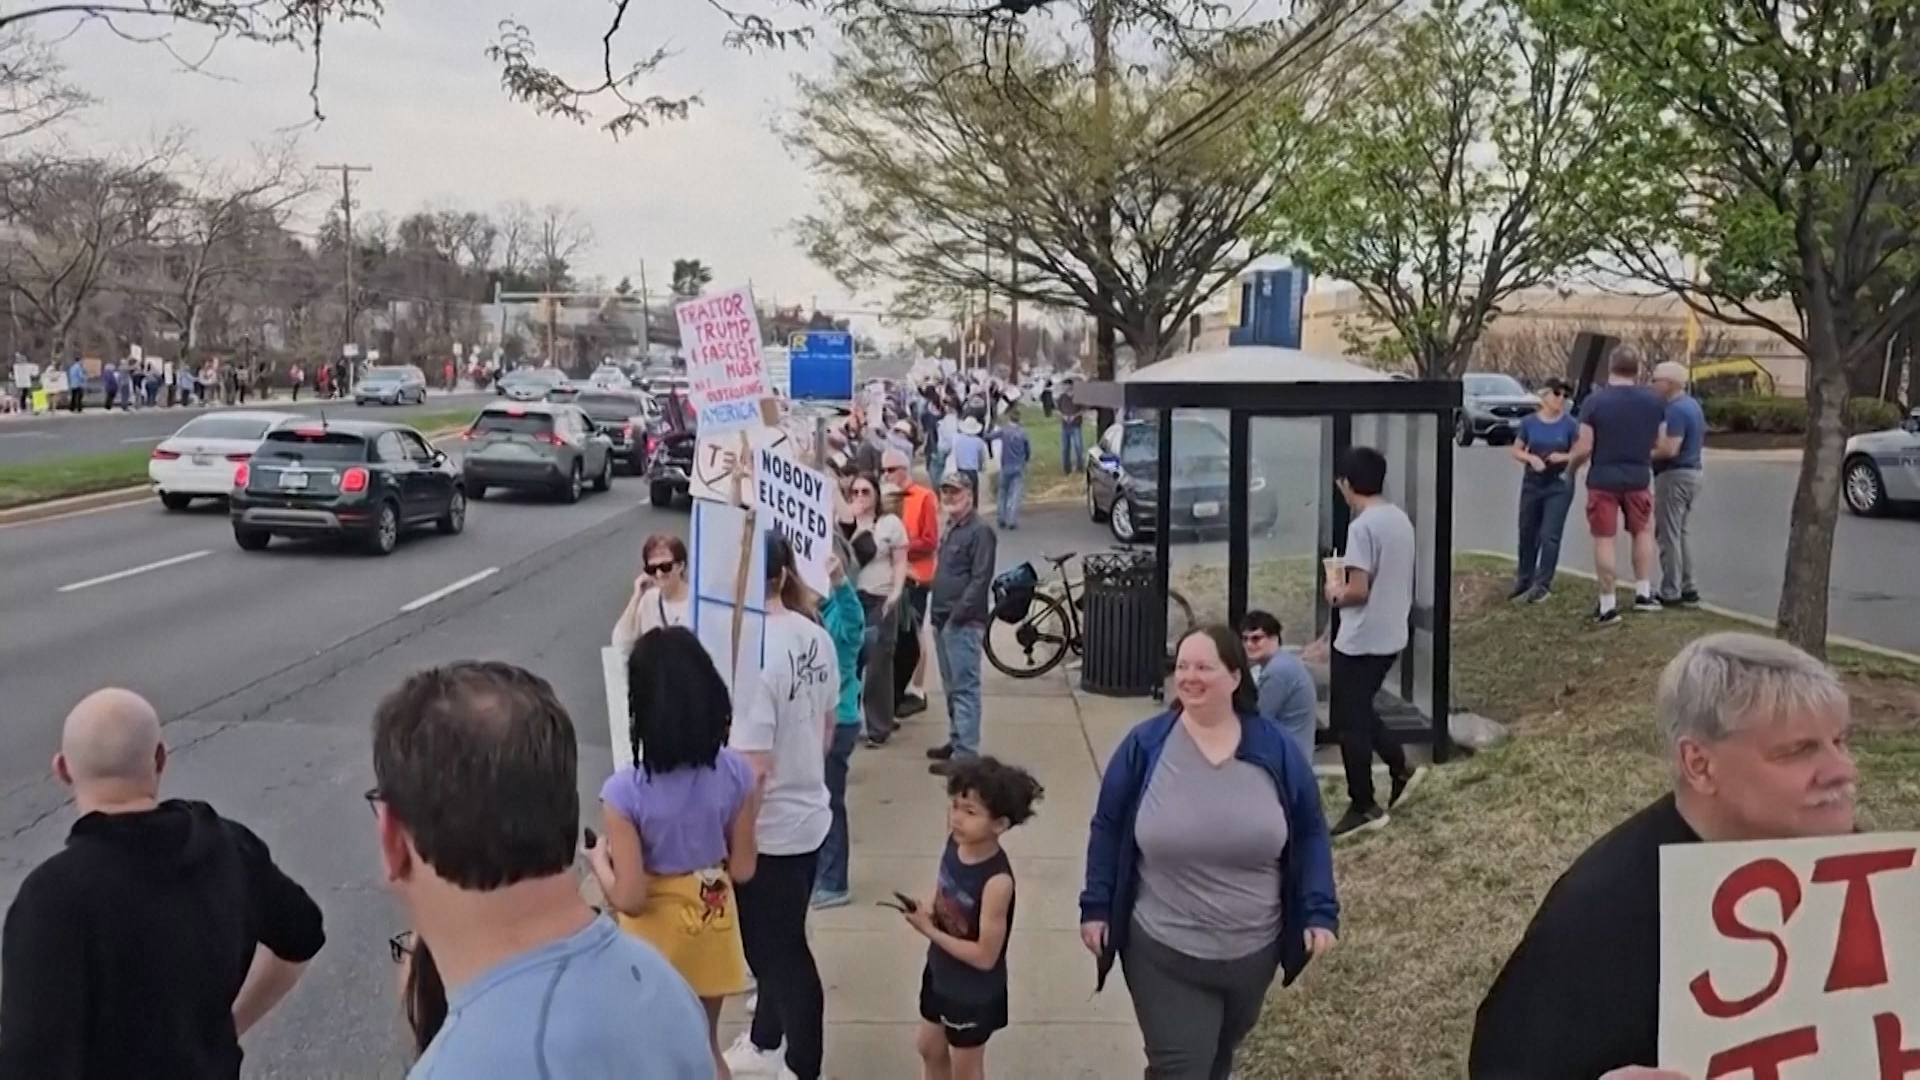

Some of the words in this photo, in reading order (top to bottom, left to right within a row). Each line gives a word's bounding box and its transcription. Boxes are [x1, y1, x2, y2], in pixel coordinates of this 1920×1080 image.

[679, 293, 746, 325] TRAITOR
[695, 318, 751, 343] TRUMP
[702, 338, 756, 365] FASCIST
[726, 360, 762, 379] MUSK
[702, 401, 759, 424] AMERICA
[761, 449, 824, 502] NOBODY
[759, 479, 827, 539] ELECTED
[1690, 847, 1917, 1018] ST
